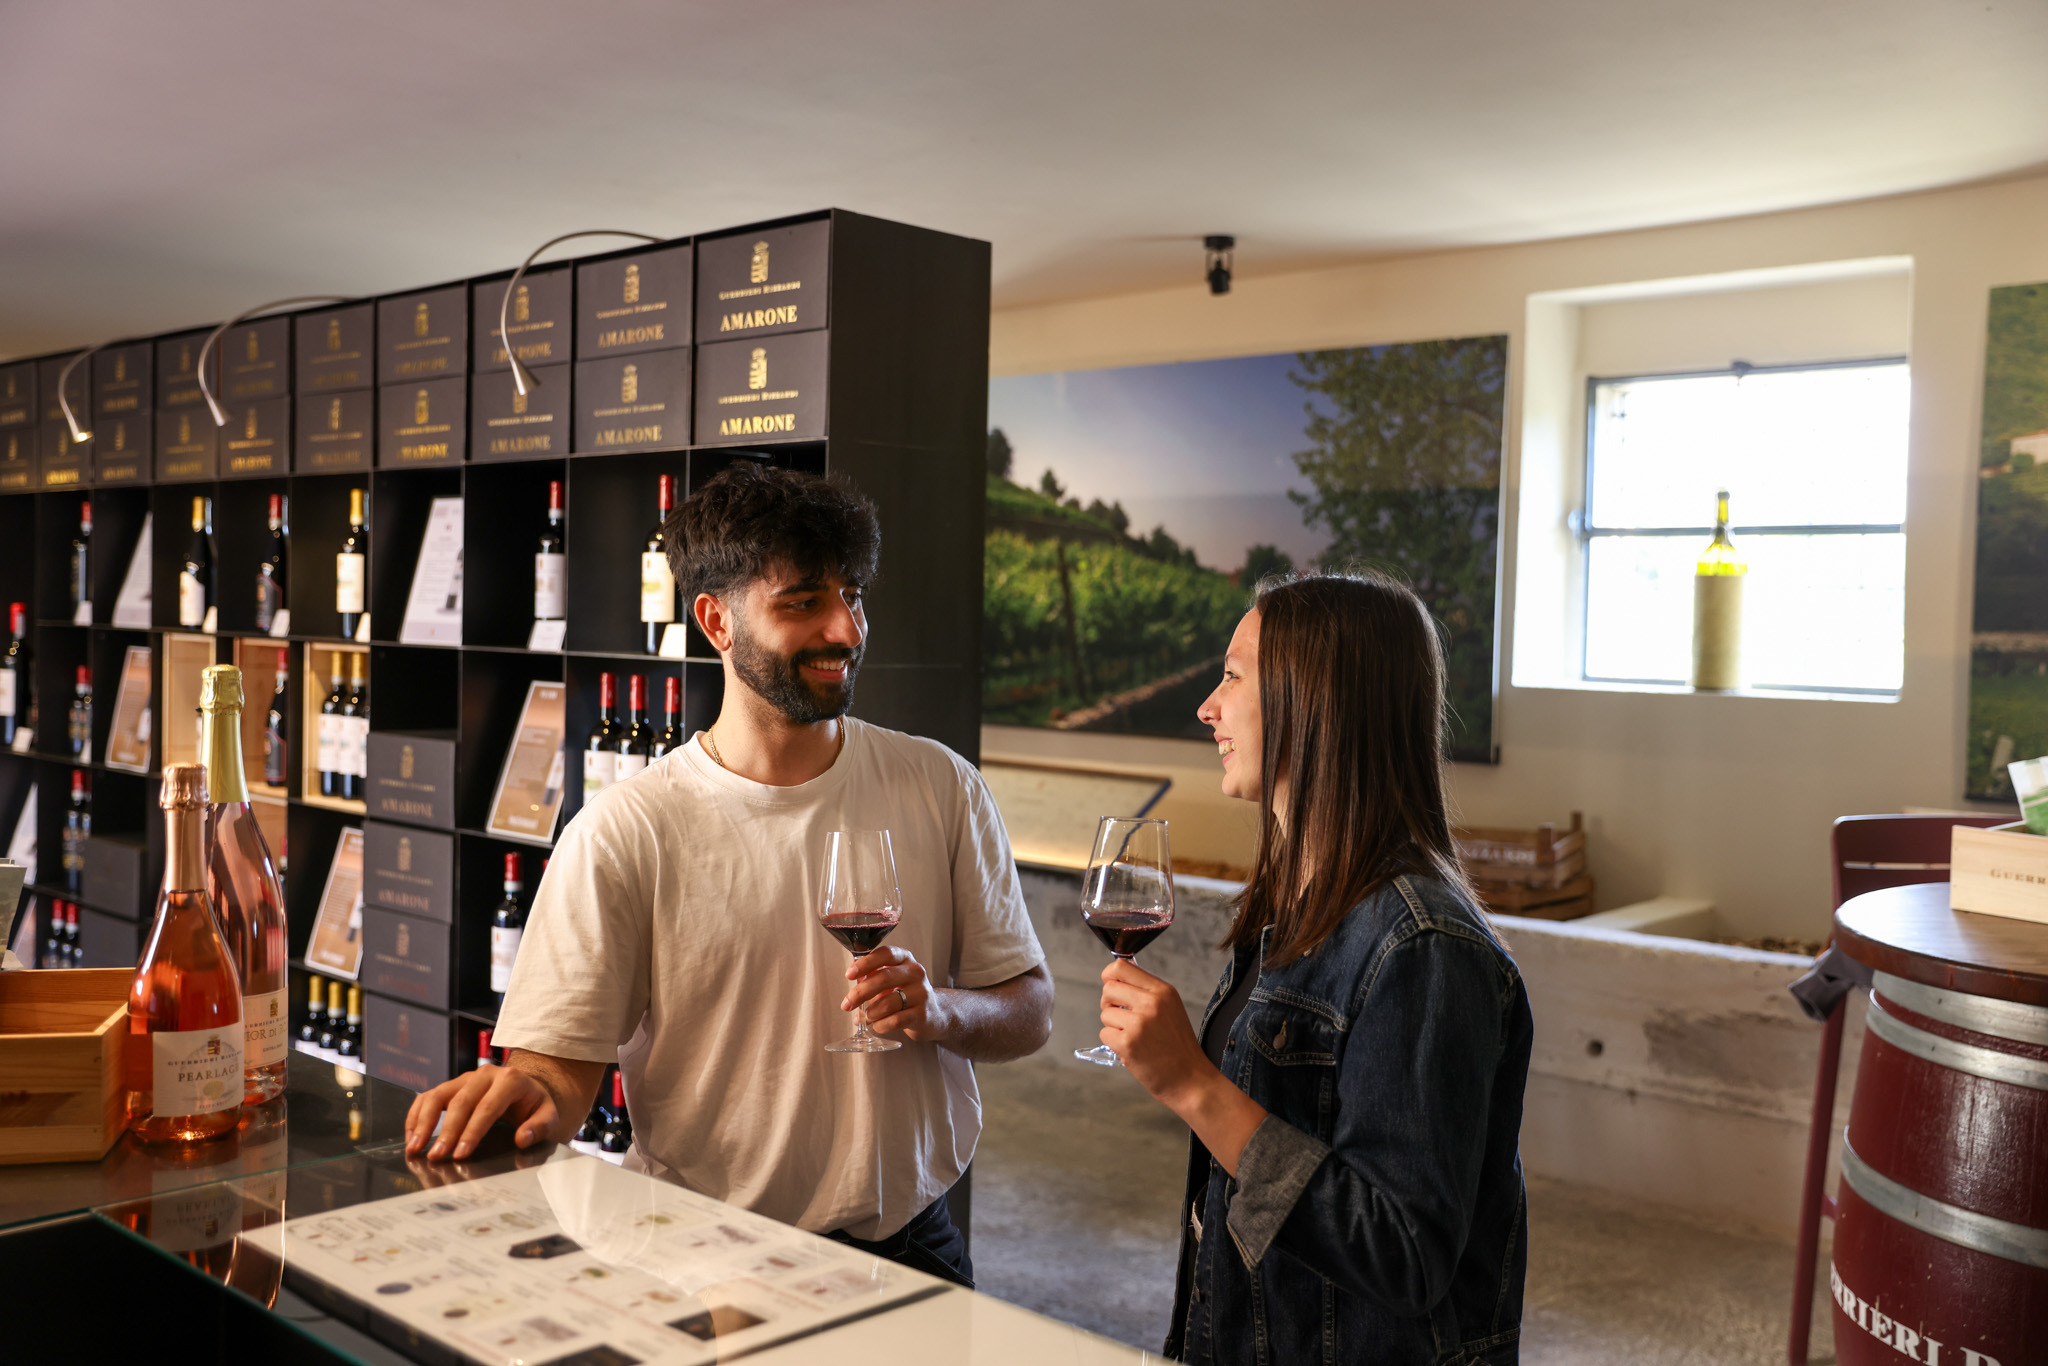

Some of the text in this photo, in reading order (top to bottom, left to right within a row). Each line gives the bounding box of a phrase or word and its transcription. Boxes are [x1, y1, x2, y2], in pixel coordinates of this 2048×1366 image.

[720, 304, 798, 332] AMARONE
[598, 323, 664, 348] AMARONE
[491, 341, 552, 363] AMRONE
[594, 424, 662, 446] AMARONE
[719, 413, 796, 436] AMARONE
[245, 1029, 266, 1042] IOR
[178, 1063, 239, 1082] PEARLAGE
